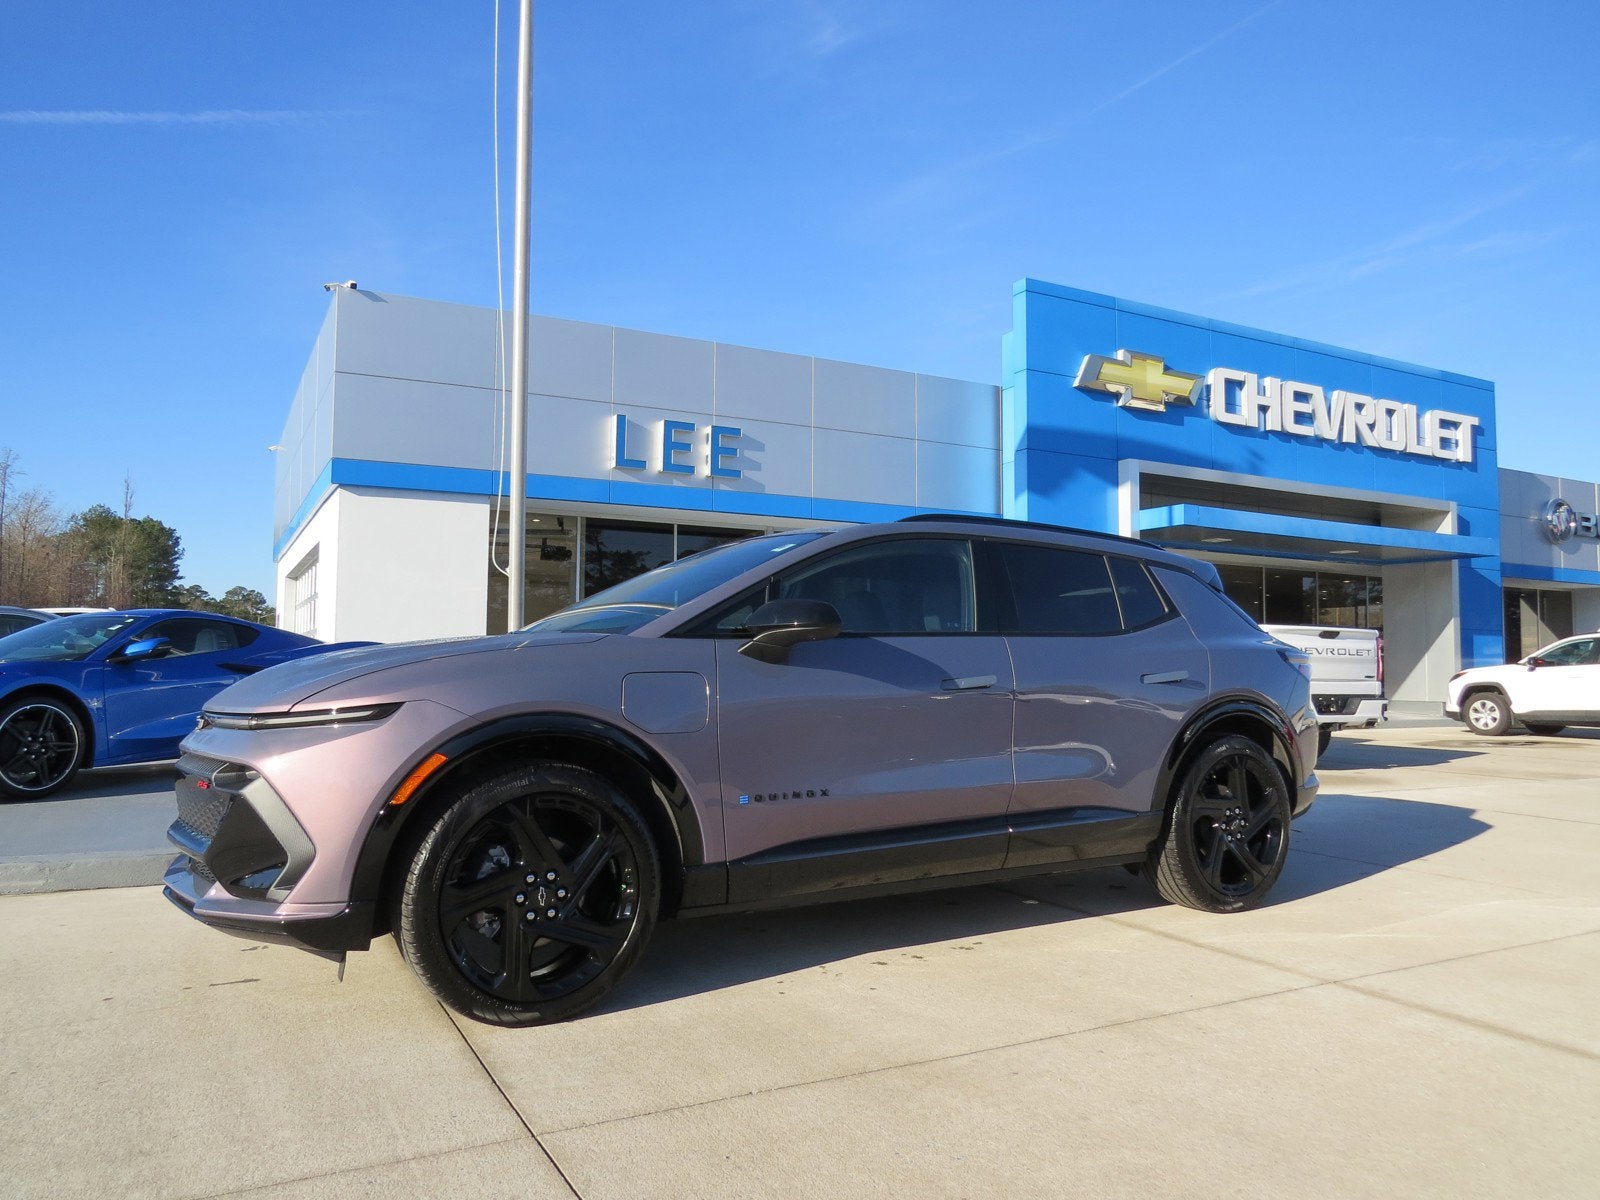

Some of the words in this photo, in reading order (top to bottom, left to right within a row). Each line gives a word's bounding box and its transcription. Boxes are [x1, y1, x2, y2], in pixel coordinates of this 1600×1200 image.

[1208, 367, 1479, 463] CHEVROLET
[611, 414, 742, 479] LEE
[1575, 512, 1600, 538] B
[1300, 647, 1372, 657] EVROLET
